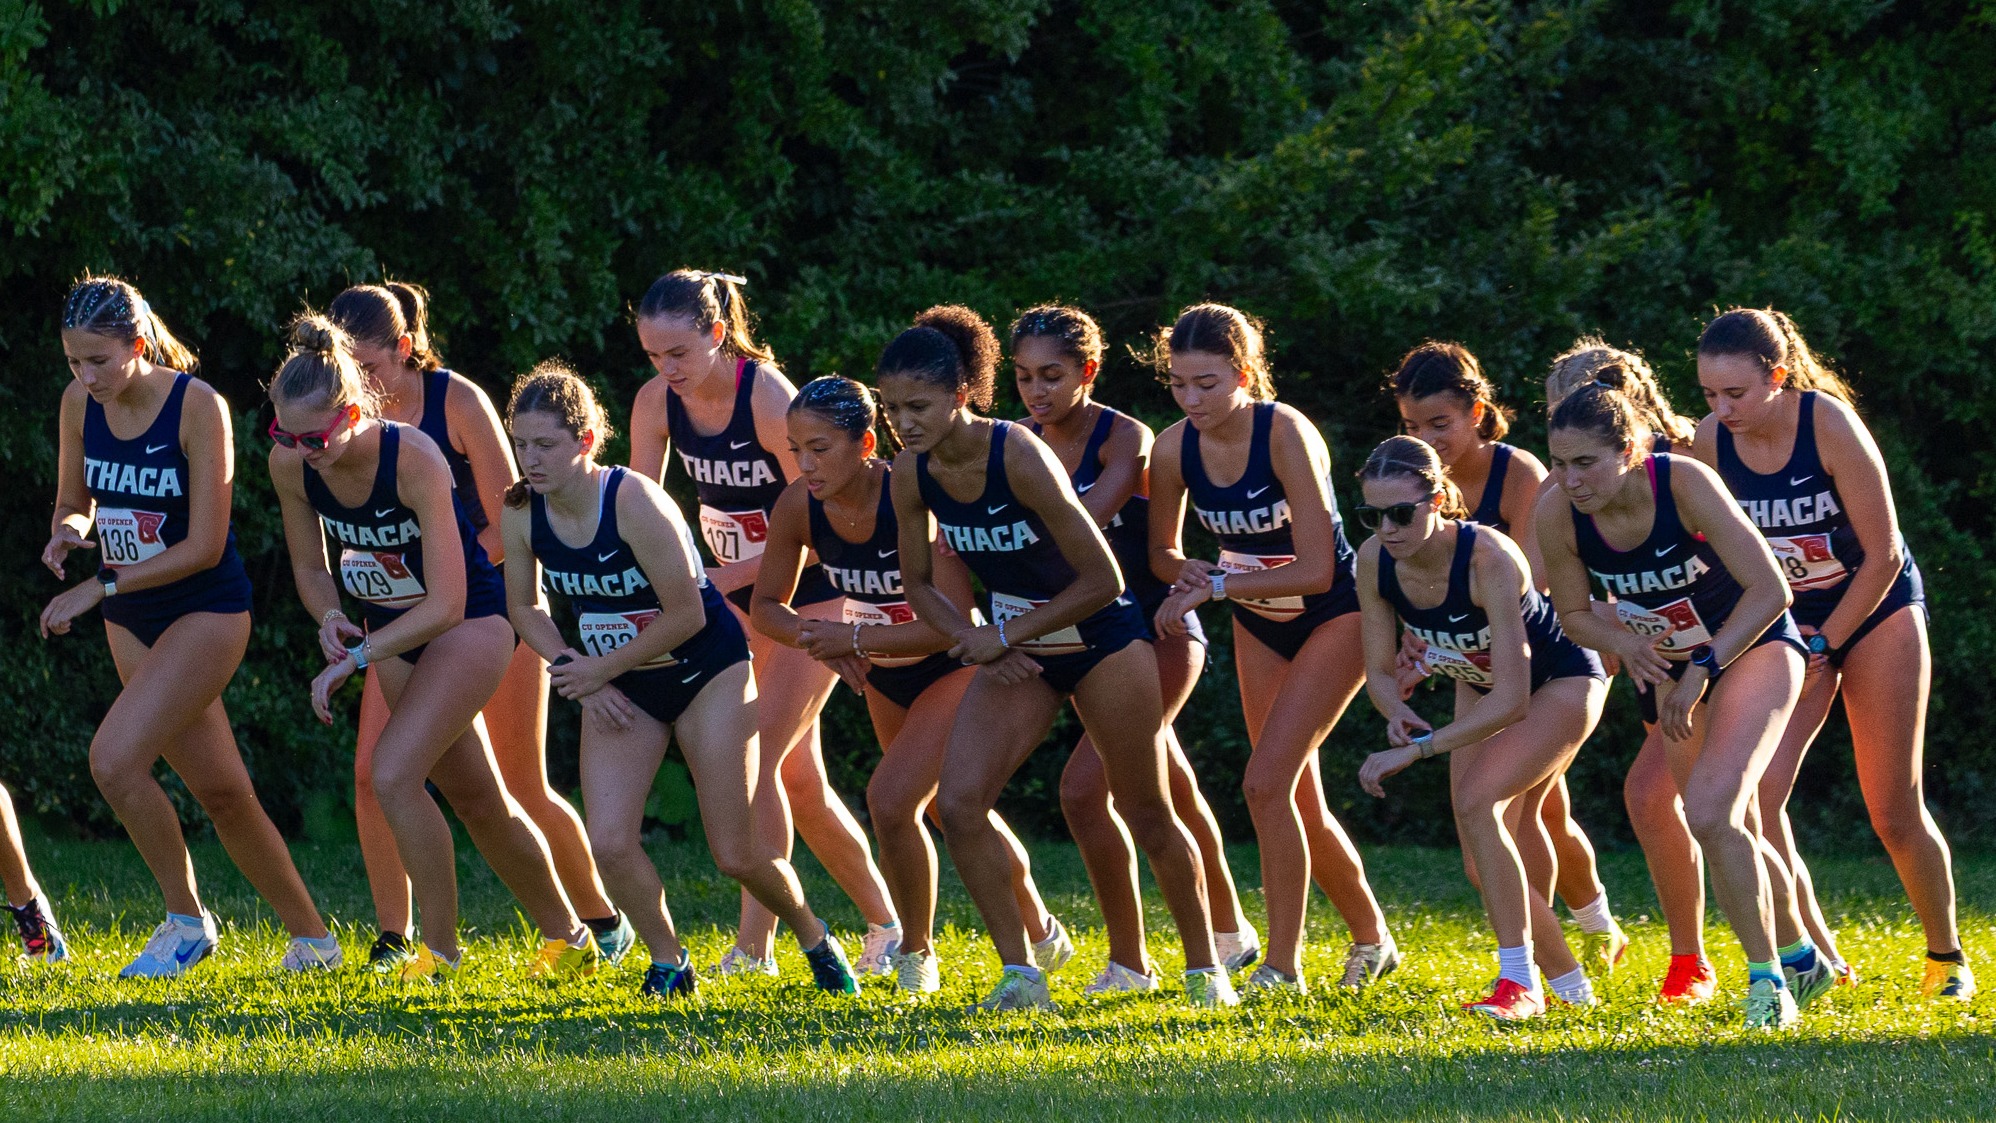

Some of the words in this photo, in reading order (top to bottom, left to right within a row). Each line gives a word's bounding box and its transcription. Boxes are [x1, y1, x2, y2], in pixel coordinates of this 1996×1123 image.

[83, 457, 183, 497] THACA
[676, 450, 777, 488] THACA
[97, 518, 106, 526] CU
[107, 518, 134, 526] OPENER
[319, 517, 422, 548] THACA
[1195, 499, 1293, 535] THACA
[101, 528, 139, 561] 136
[707, 527, 740, 560] 127
[938, 520, 1040, 552] THACA
[352, 560, 377, 568] OPENER
[822, 563, 905, 595] THAC
[1588, 555, 1711, 595] THACA
[347, 570, 393, 597] 129
[544, 566, 650, 597] THACA
[581, 623, 593, 631] CU
[594, 622, 630, 630] OPENER
[1431, 663, 1487, 682] 135
